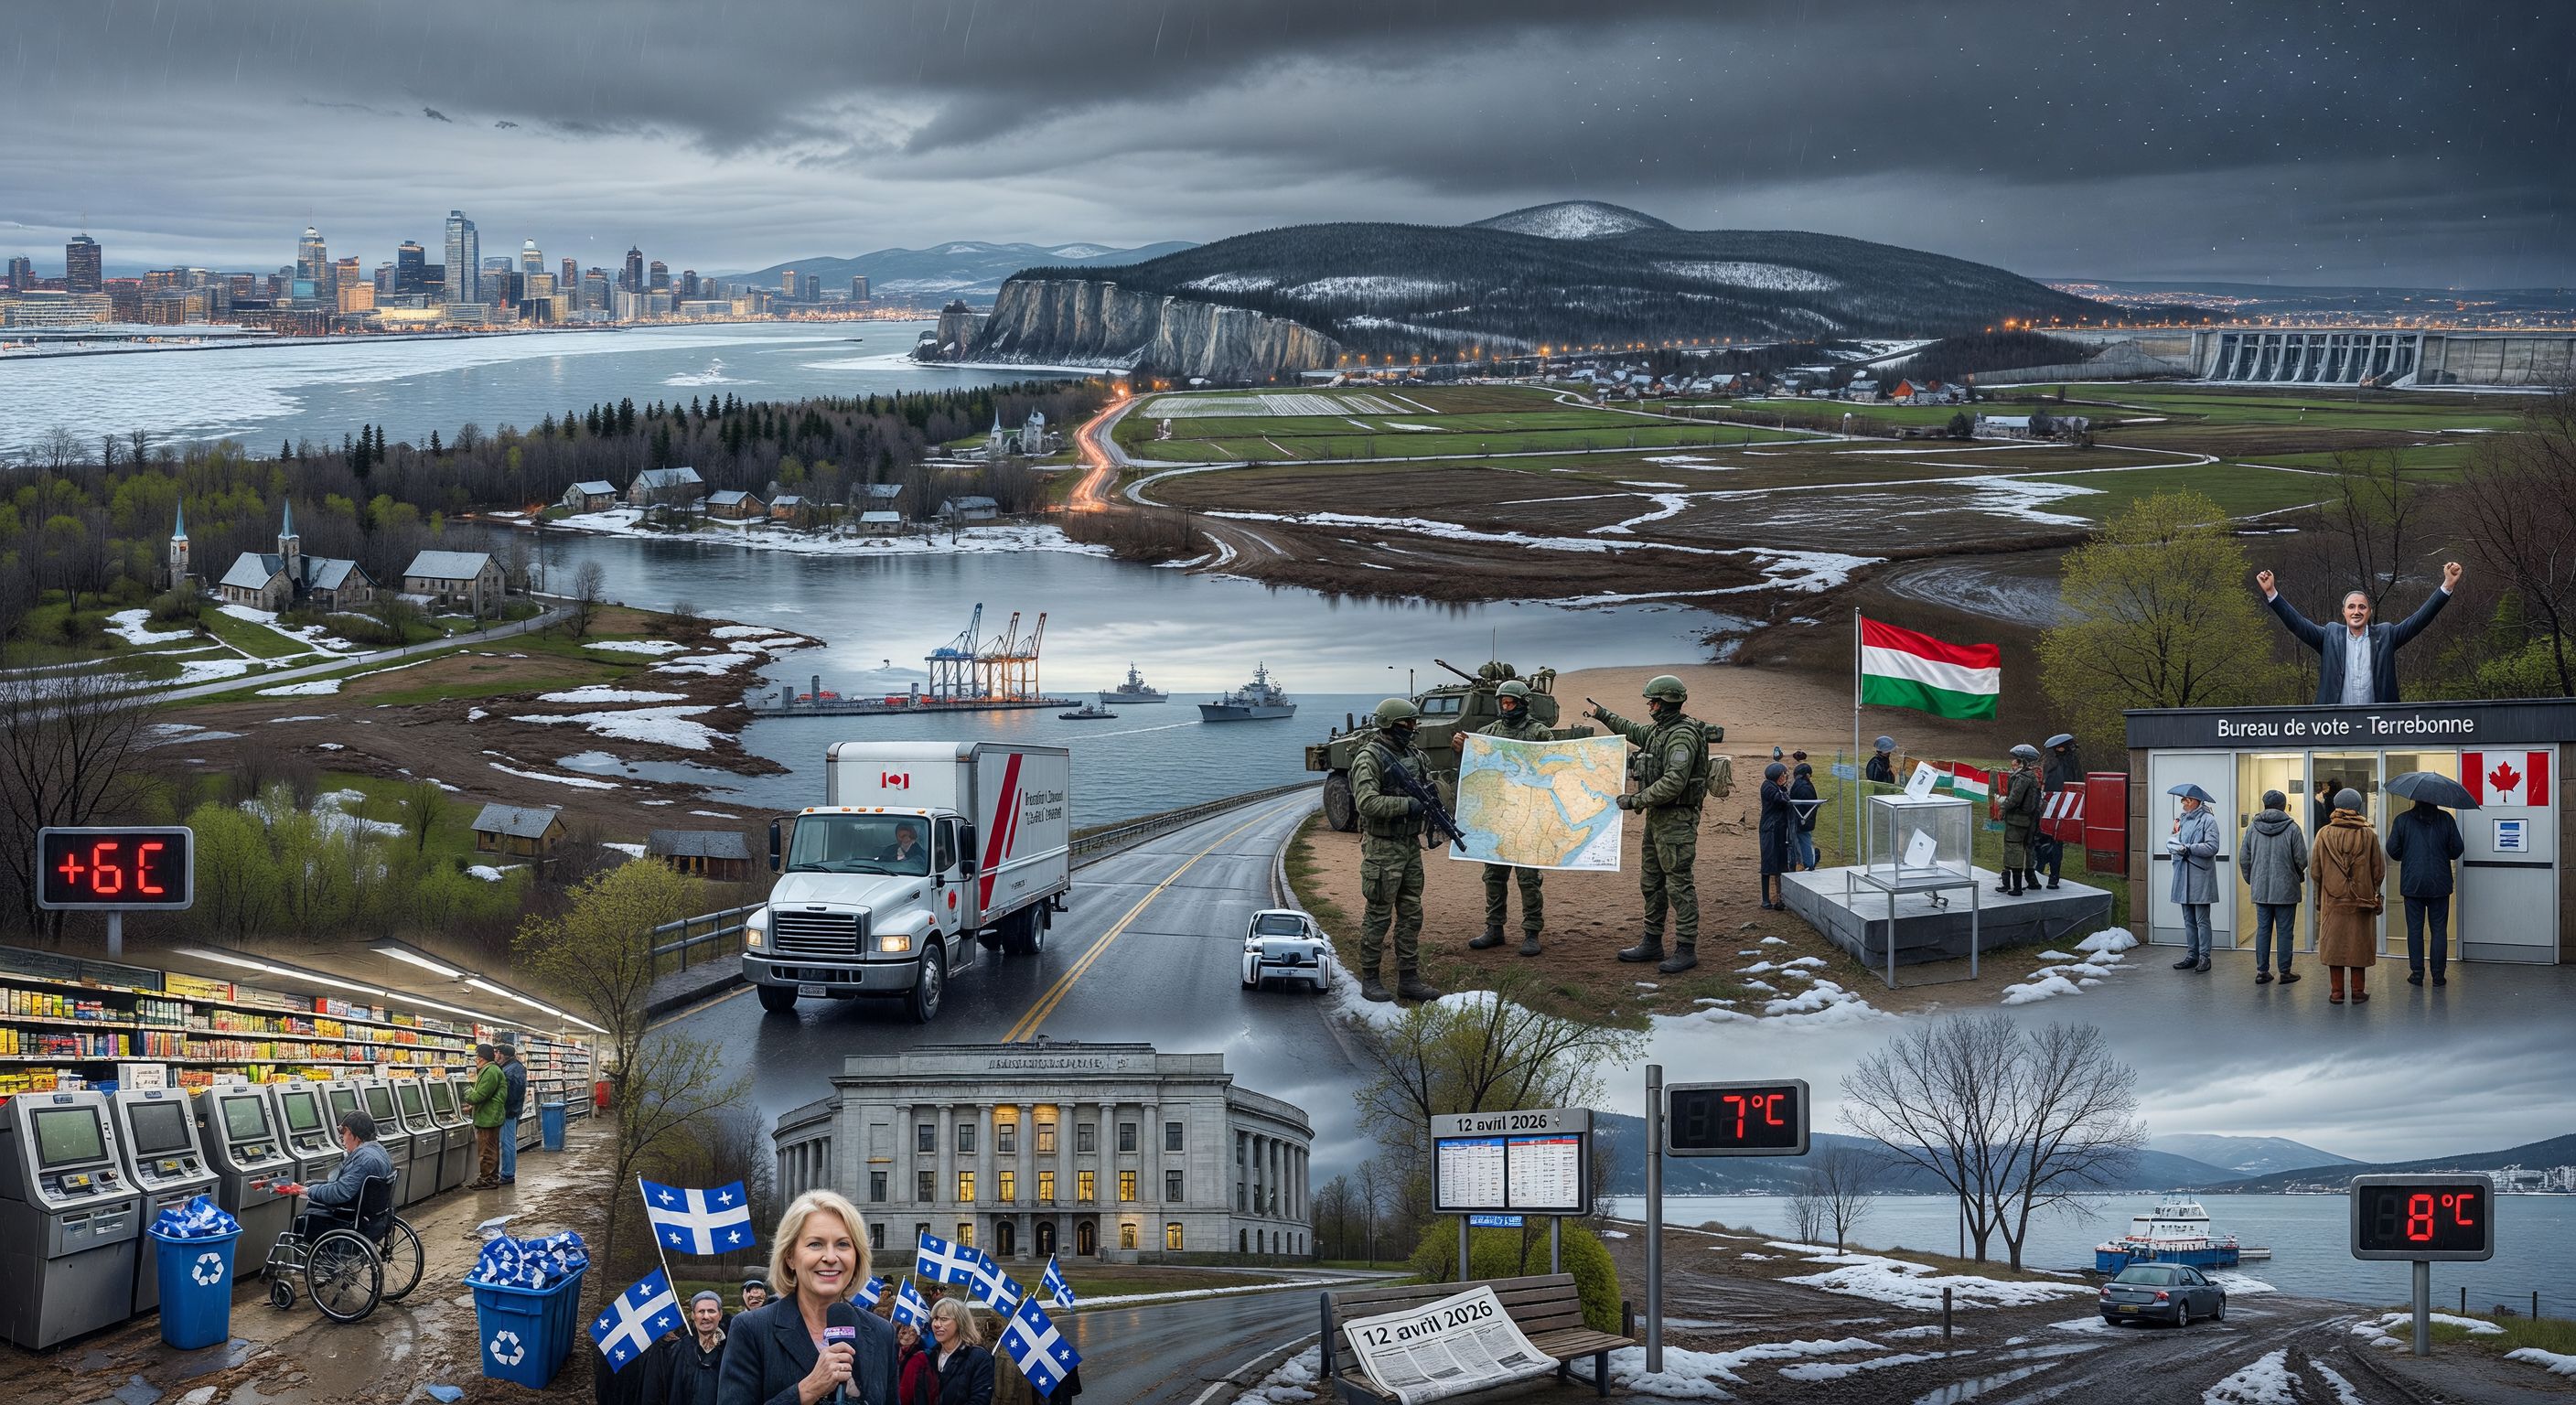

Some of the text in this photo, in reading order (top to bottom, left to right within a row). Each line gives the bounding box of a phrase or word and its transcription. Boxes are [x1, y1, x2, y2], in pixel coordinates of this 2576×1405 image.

[2217, 719, 2279, 737] Bureau
[2284, 719, 2306, 735] de
[2312, 718, 2350, 735] vote
[2367, 715, 2474, 735] Terrebonne
[1456, 1114, 1548, 1132] 12 avril 2026
[1362, 1300, 1493, 1346] 12 avril 2026
